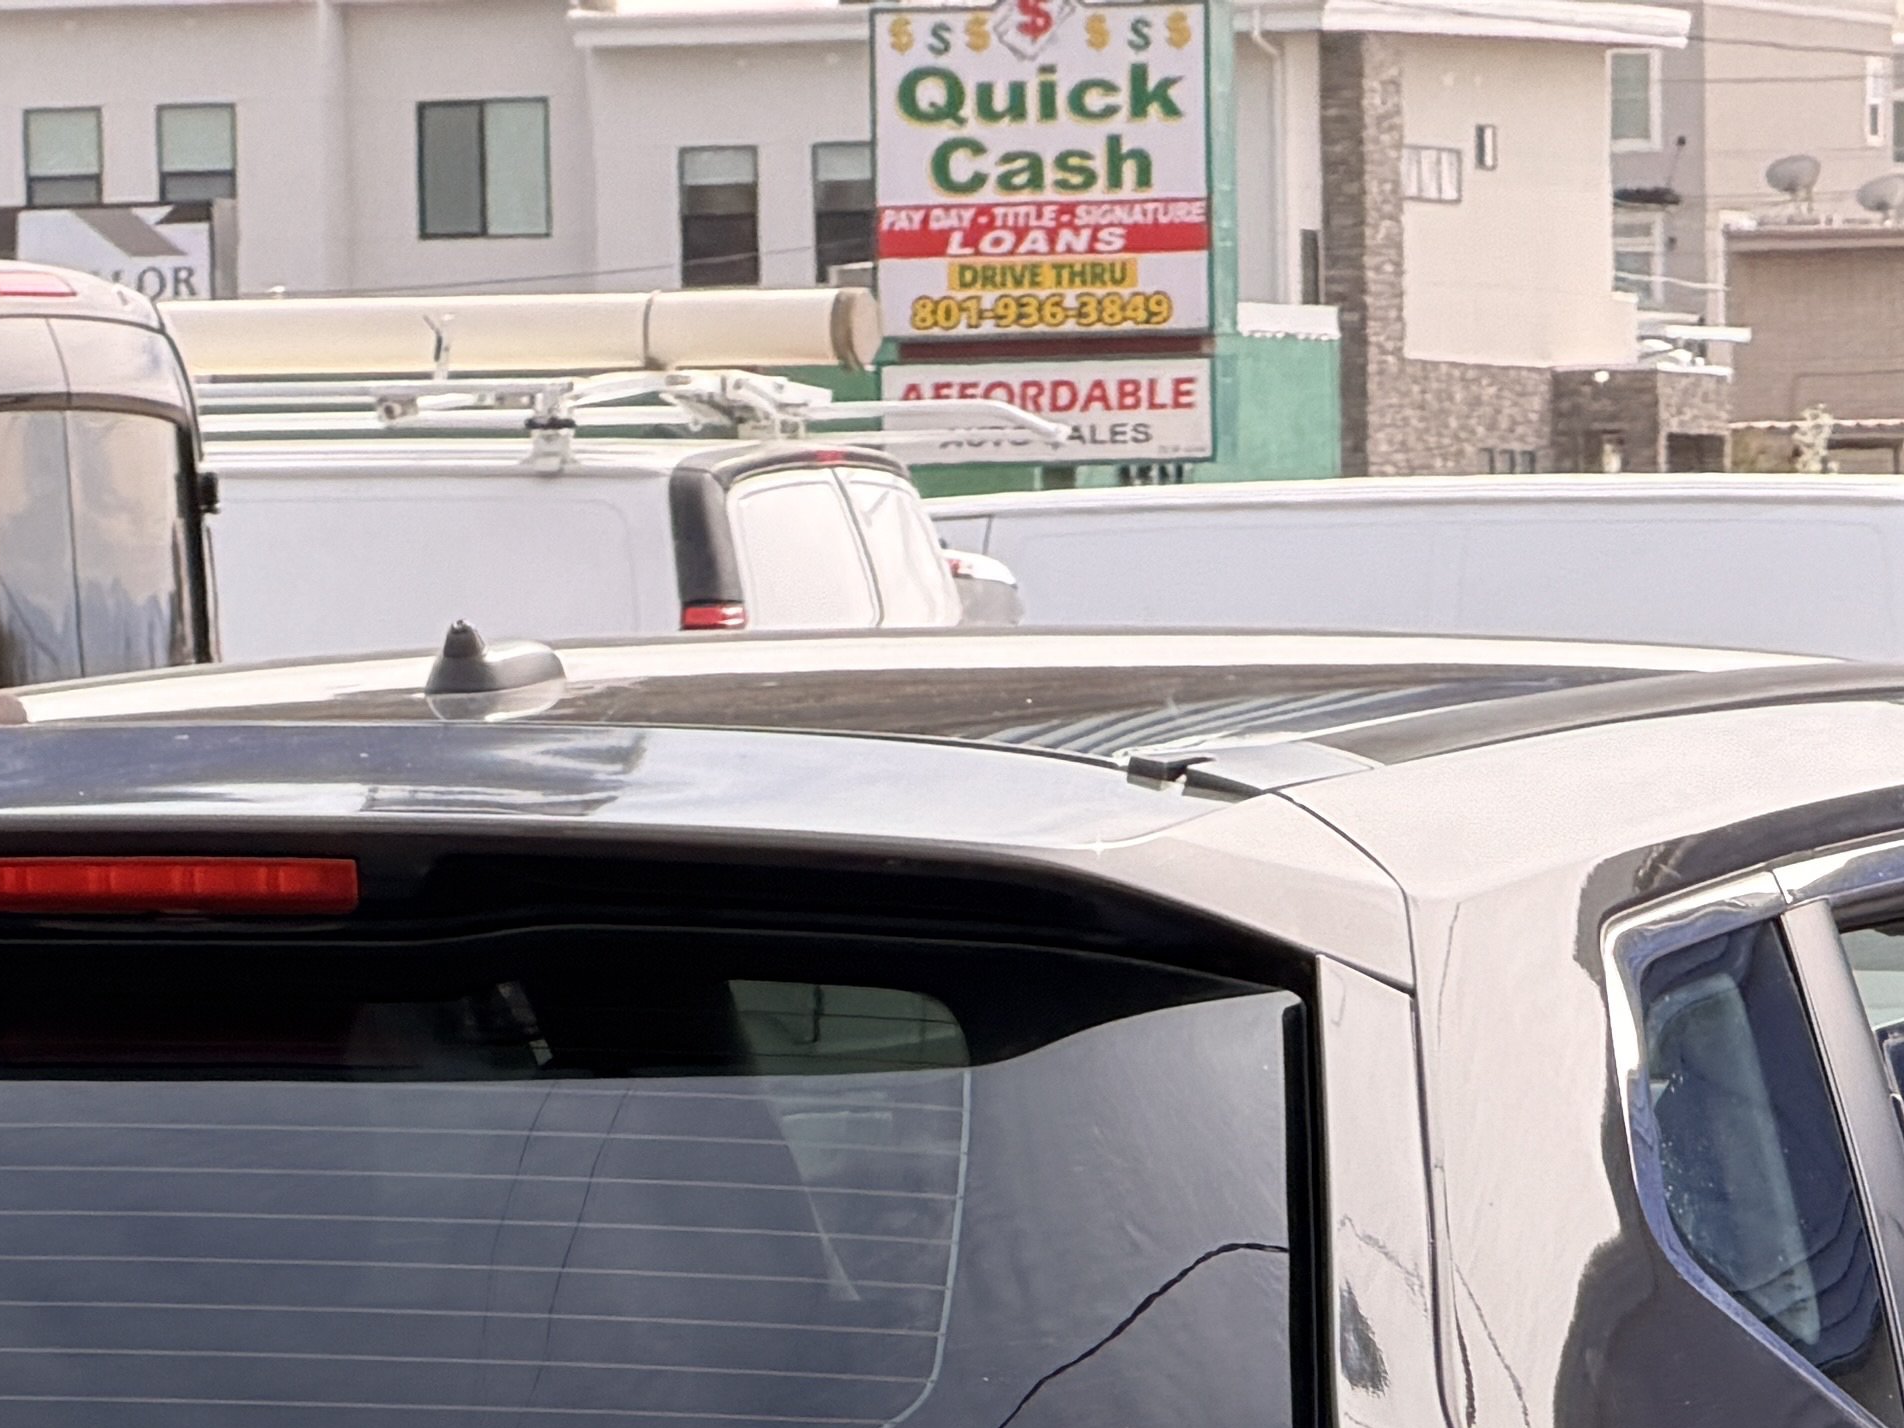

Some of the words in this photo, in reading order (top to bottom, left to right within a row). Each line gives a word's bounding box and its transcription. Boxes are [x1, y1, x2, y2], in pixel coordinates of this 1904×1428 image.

[898, 63, 1184, 127] Quick
[930, 134, 1152, 194] Cash
[882, 210, 924, 230] PAY
[929, 208, 974, 229] DAY
[992, 206, 1058, 227] TITLE
[1075, 202, 1206, 226] SIGNATURE
[946, 227, 1127, 255] LOANS
[958, 263, 1043, 289] DRIVE
[1052, 262, 1128, 286] THRU
[911, 291, 1173, 330] 801-936-3849
[1045, 423, 1153, 450] ALES
